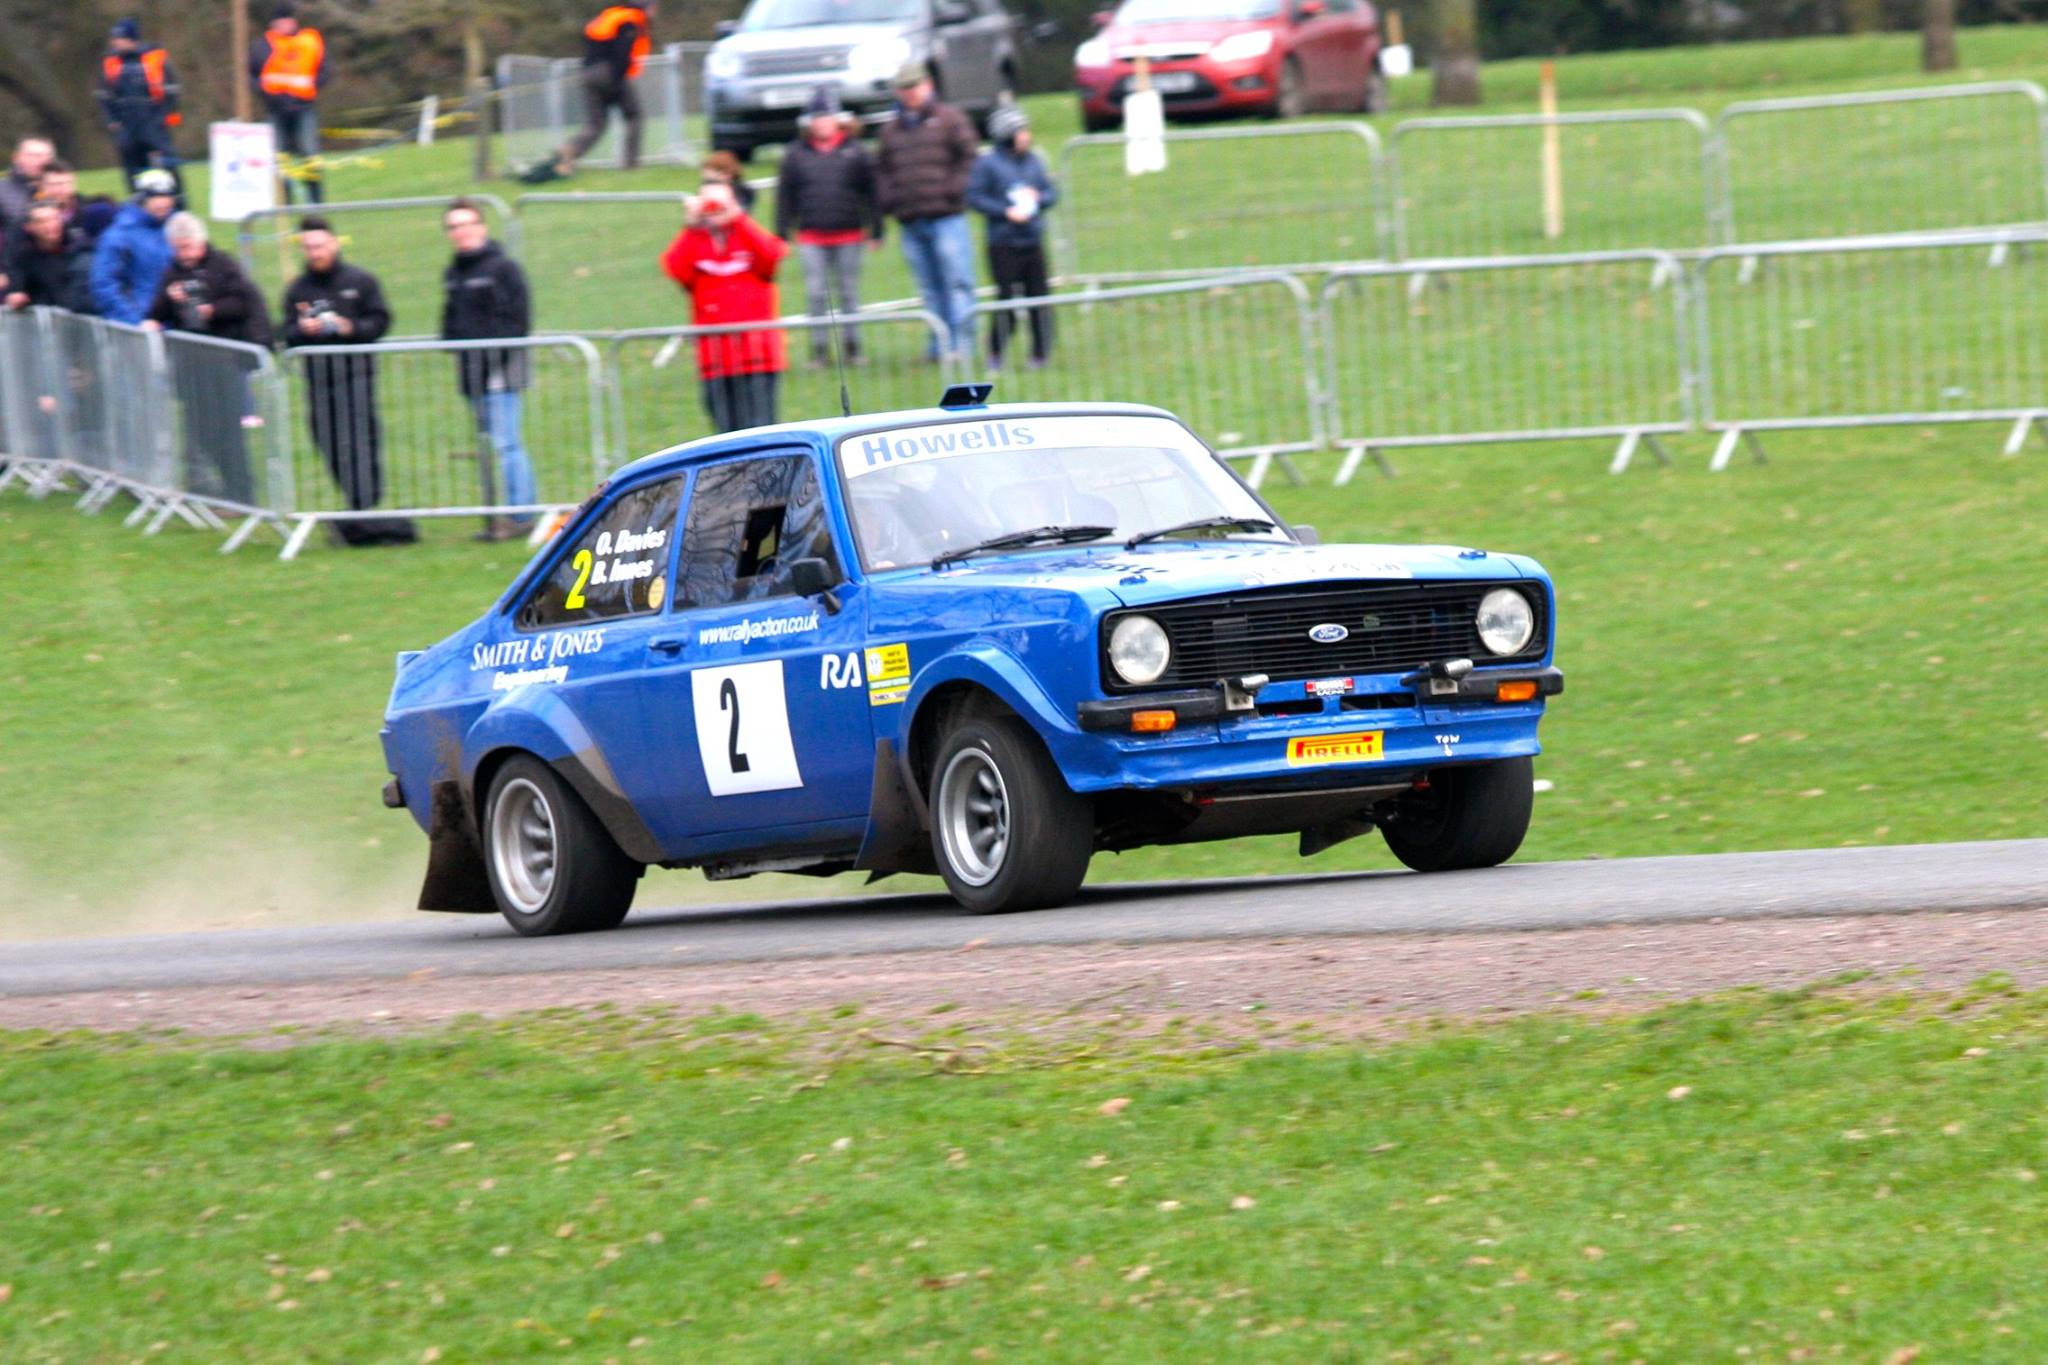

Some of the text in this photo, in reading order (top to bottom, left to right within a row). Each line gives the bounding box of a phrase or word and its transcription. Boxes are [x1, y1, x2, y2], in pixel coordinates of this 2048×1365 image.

[861, 423, 1035, 466] Howells
[615, 526, 666, 552] Davies
[565, 549, 592, 610] 2
[609, 558, 654, 582] Innes
[700, 610, 819, 645] www.rallyaction.co.uk
[470, 629, 606, 671] SMITH & JONES
[821, 652, 862, 690] RA
[720, 677, 751, 774] 2
[1434, 734, 1461, 744] TOW
[1296, 735, 1375, 759] PIRELLI
